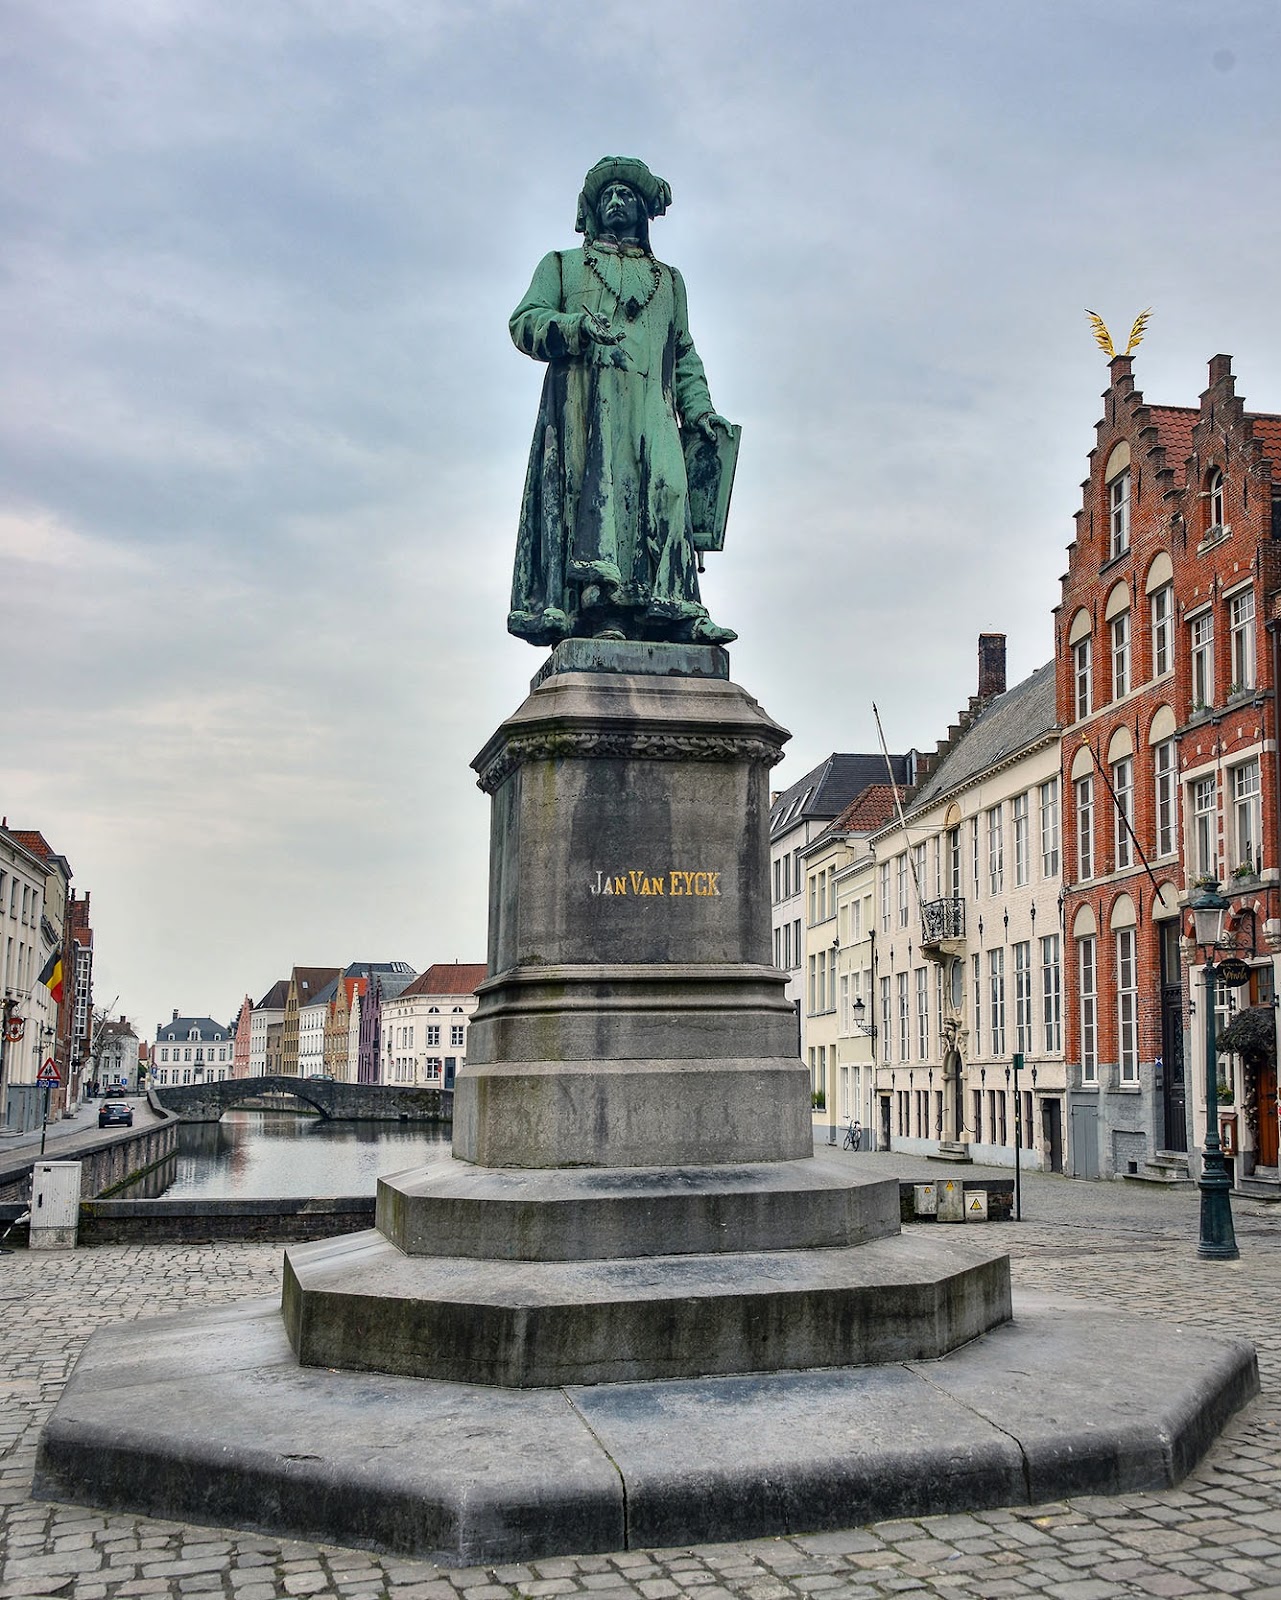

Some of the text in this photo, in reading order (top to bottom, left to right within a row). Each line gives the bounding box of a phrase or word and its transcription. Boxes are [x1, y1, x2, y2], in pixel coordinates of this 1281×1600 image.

[589, 870, 722, 896] JAN VAN EYCK
